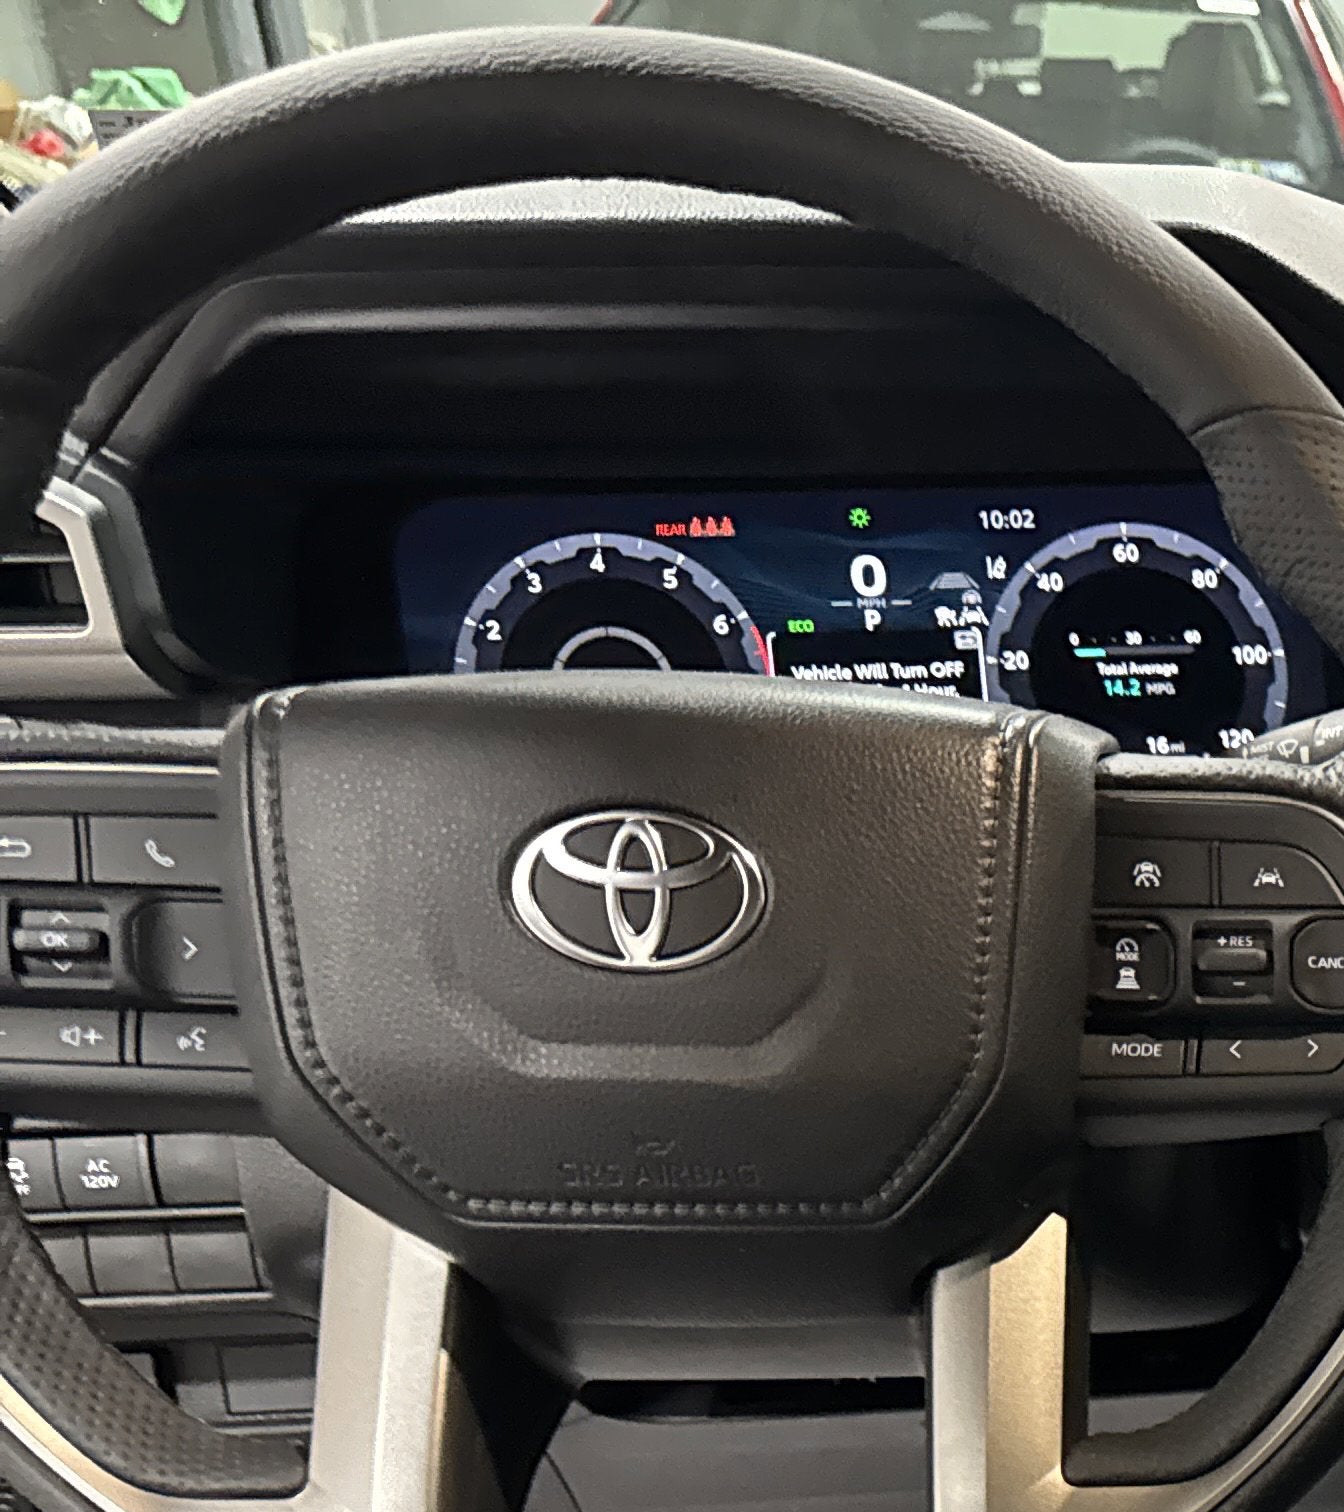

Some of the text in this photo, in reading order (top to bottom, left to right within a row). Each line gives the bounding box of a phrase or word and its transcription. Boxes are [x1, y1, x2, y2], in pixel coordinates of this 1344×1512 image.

[979, 508, 1036, 530] 10:02
[655, 523, 687, 537] REAR
[589, 552, 605, 574] 4
[1113, 543, 1140, 564] 60
[527, 573, 543, 595] 3
[662, 567, 679, 590] 5
[850, 554, 887, 597] 0
[1037, 571, 1064, 593] 40
[1192, 567, 1219, 590] 80
[484, 620, 503, 642] 2
[712, 613, 730, 636] 6
[787, 619, 814, 633] ECO
[864, 609, 882, 632] P
[1125, 631, 1142, 645] 30
[1184, 629, 1201, 644] 60
[1004, 651, 1030, 671] 20
[1232, 645, 1267, 666] 100
[791, 660, 965, 682] Vehicle Will Turn OFF
[1097, 662, 1127, 676] Total
[1103, 678, 1142, 697] 14.2
[1145, 735, 1170, 755] 16
[39, 931, 68, 949] OK
[1112, 1043, 1163, 1057] MODE
[86, 1159, 111, 1173] AC
[80, 1174, 120, 1189] 120V
